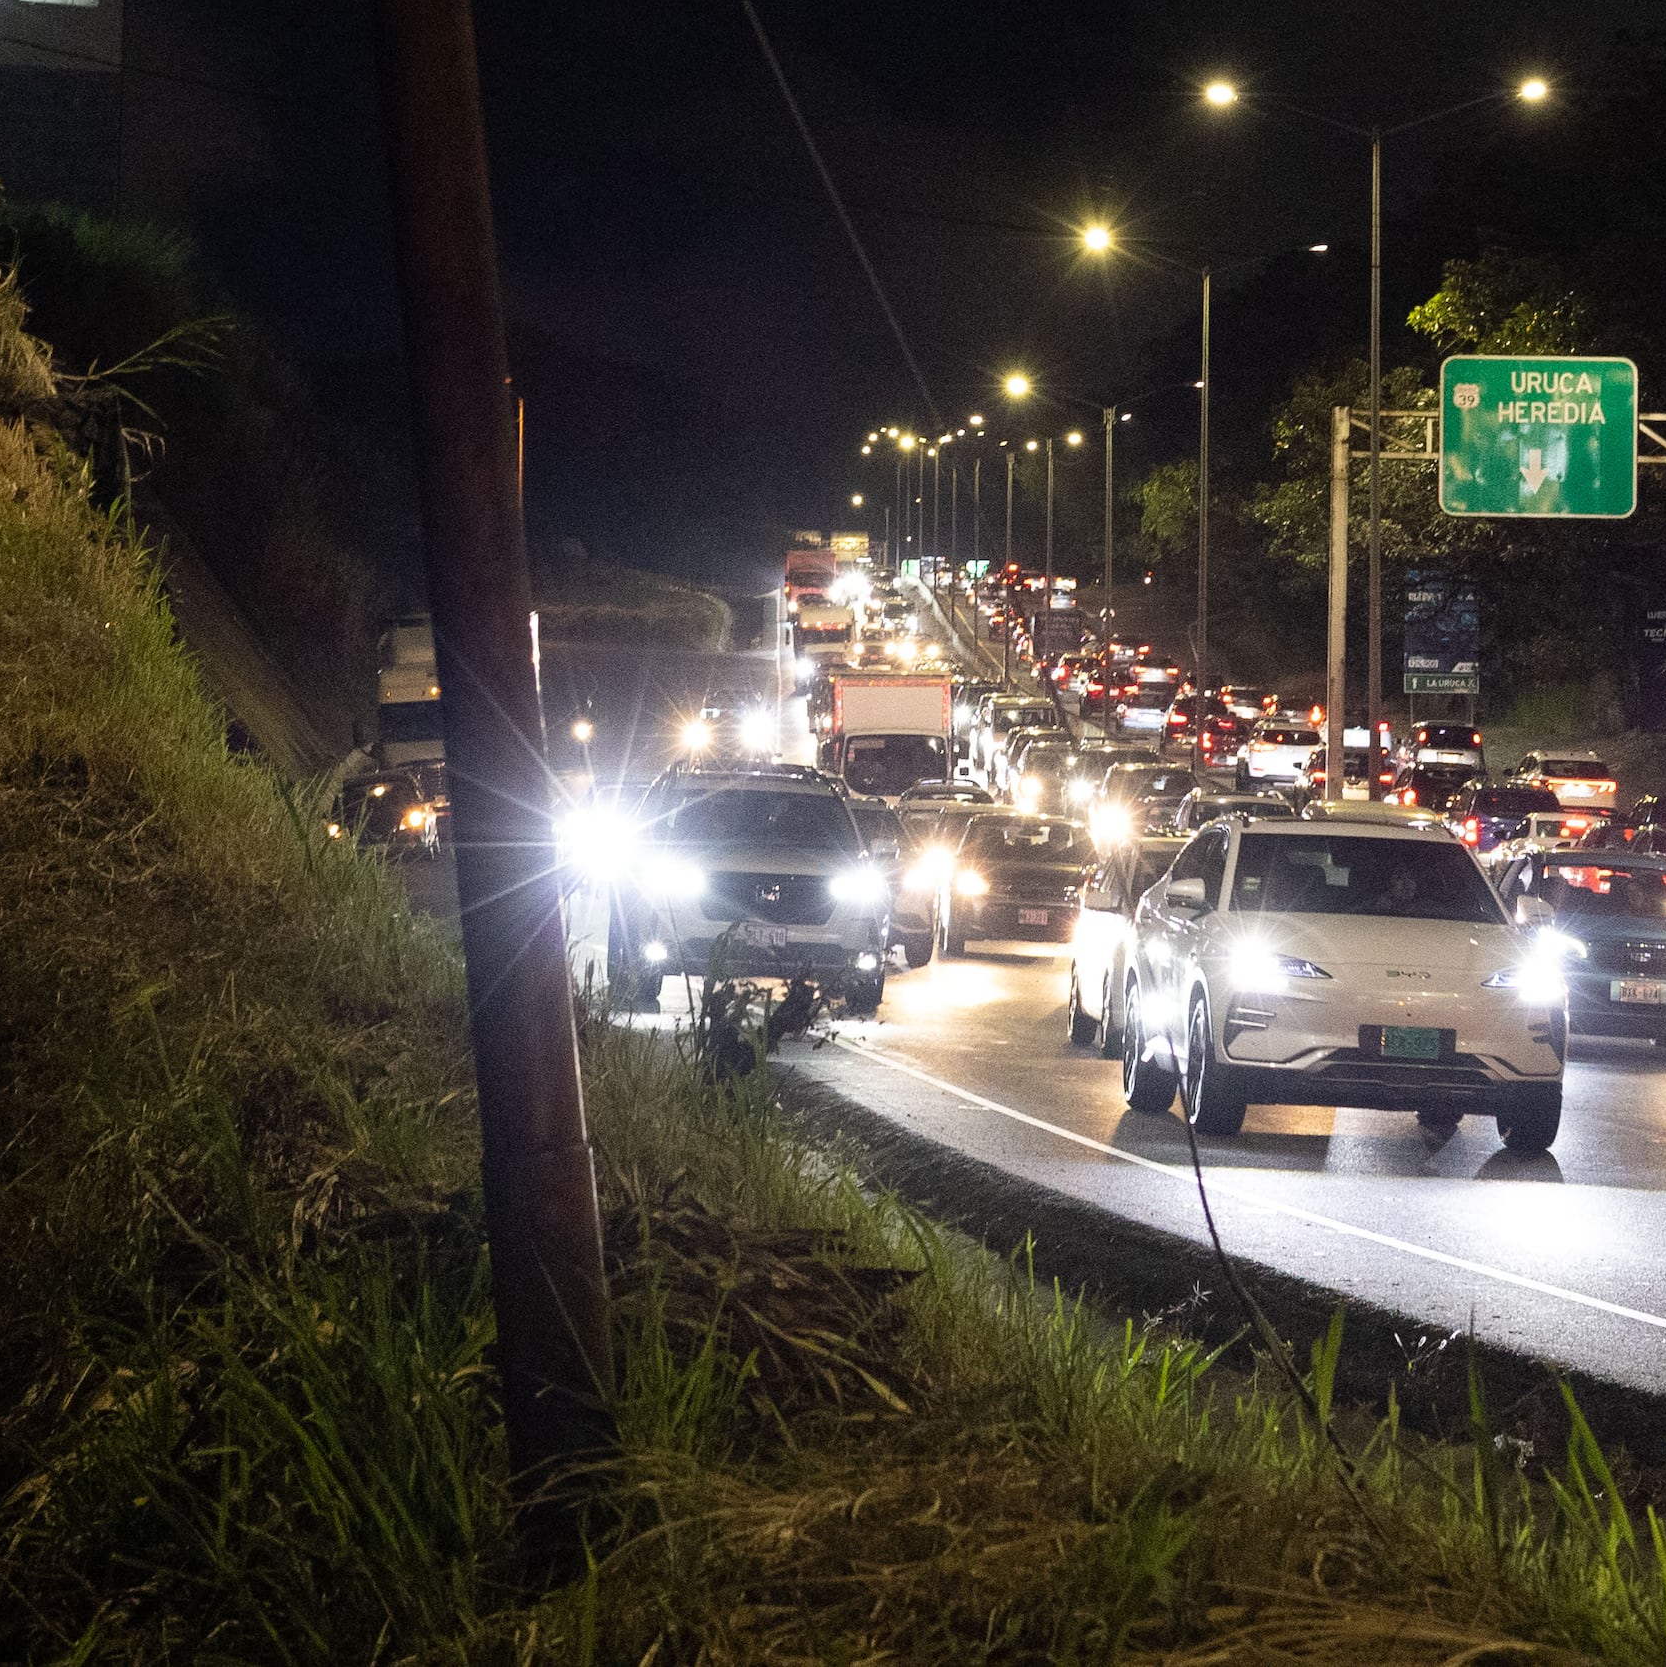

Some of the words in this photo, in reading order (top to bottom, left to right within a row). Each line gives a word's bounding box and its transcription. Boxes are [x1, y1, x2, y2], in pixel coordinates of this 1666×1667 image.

[1510, 371, 1593, 394] URUCA
[1458, 394, 1475, 406] 39
[1498, 401, 1605, 425] HEREDIA
[1426, 679, 1438, 688] LA
[1438, 678, 1467, 688] URUCA
